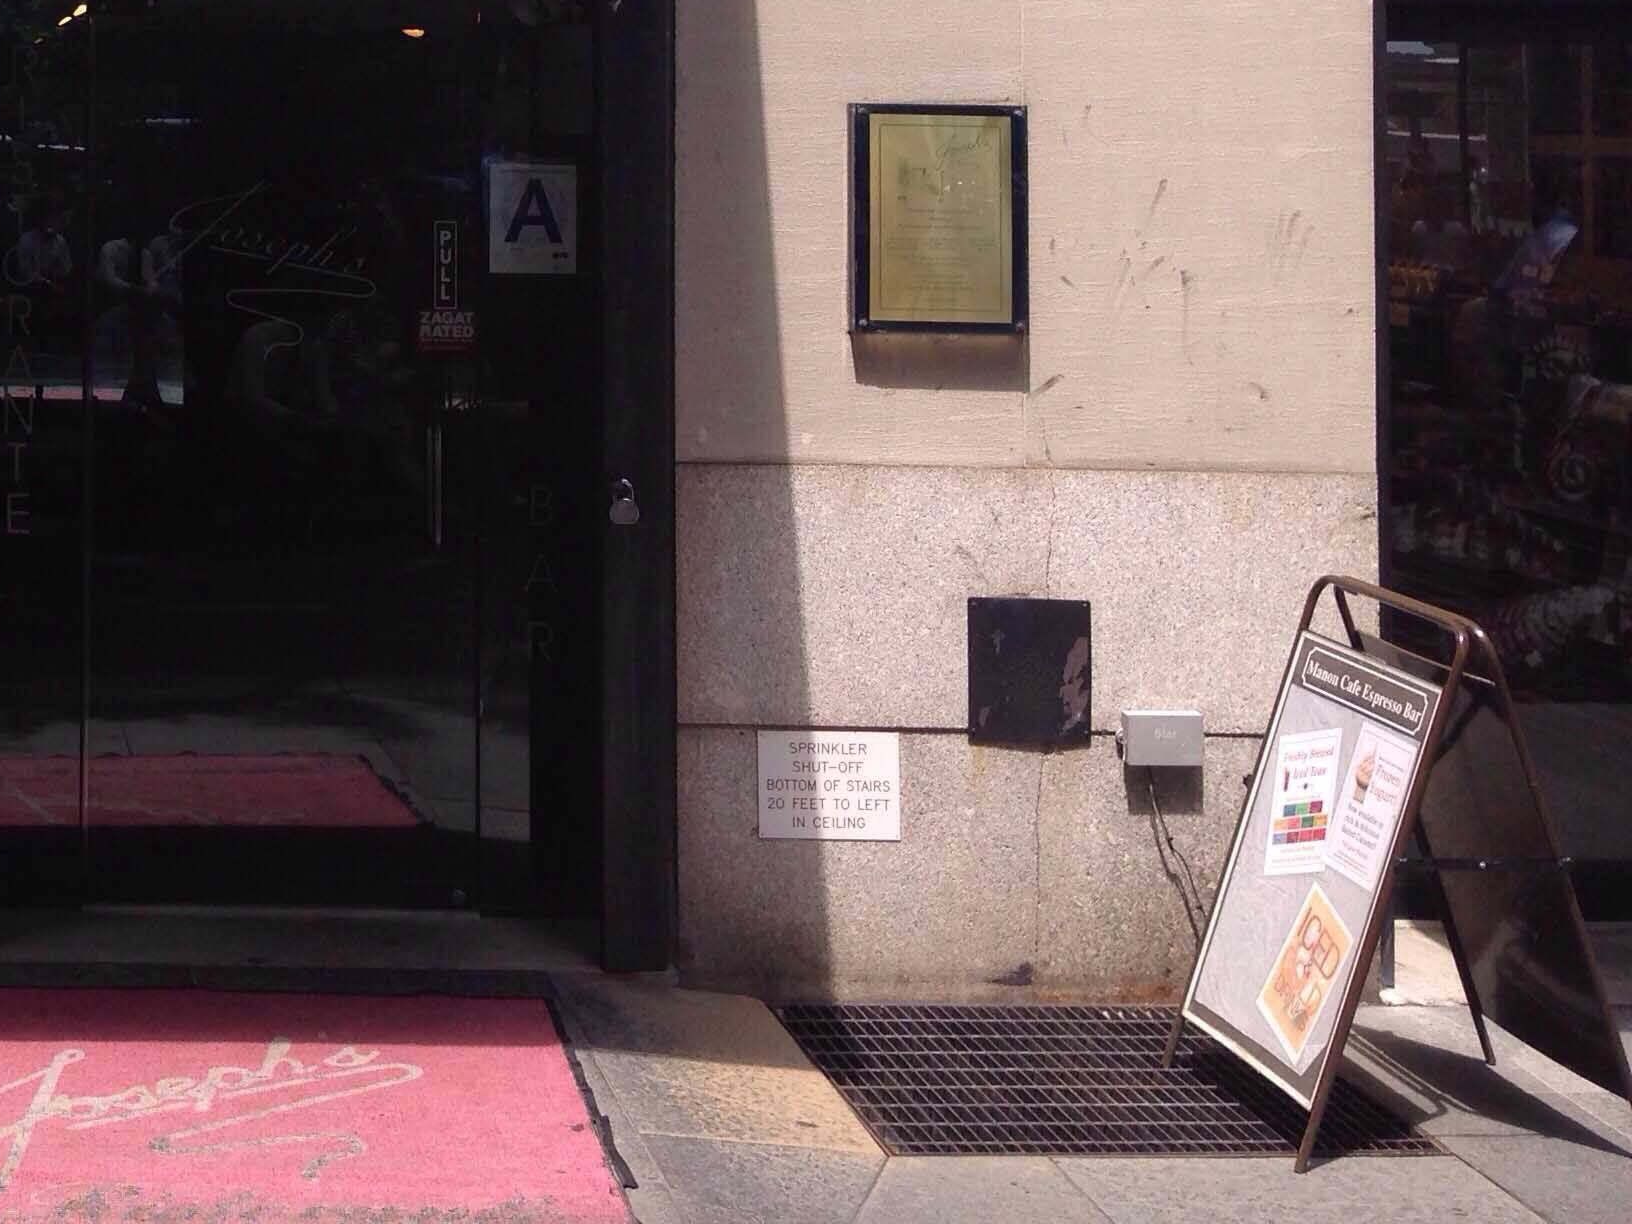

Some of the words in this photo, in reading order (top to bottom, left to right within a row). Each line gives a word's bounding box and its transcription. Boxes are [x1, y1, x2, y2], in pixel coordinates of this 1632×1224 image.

[504, 178, 563, 244] A
[438, 230, 452, 301] PULL
[419, 311, 475, 324] ZAGAT
[419, 325, 475, 338] RATED
[1306, 659, 1339, 687] Manon
[1340, 674, 1362, 696] Cafe
[1361, 684, 1403, 715] Espresso
[1402, 700, 1423, 723] Bar
[789, 742, 868, 755] SPRINKLER
[791, 760, 865, 774] SHUT-OFF
[766, 778, 817, 791] BOTTOM
[823, 779, 840, 792] OF
[846, 780, 891, 793] STAIRS
[767, 797, 785, 810] 20
[791, 797, 826, 810] FEET
[832, 798, 850, 811] TO
[857, 798, 891, 812] LEFT
[791, 816, 806, 828] IN
[812, 816, 866, 829] CEILING
